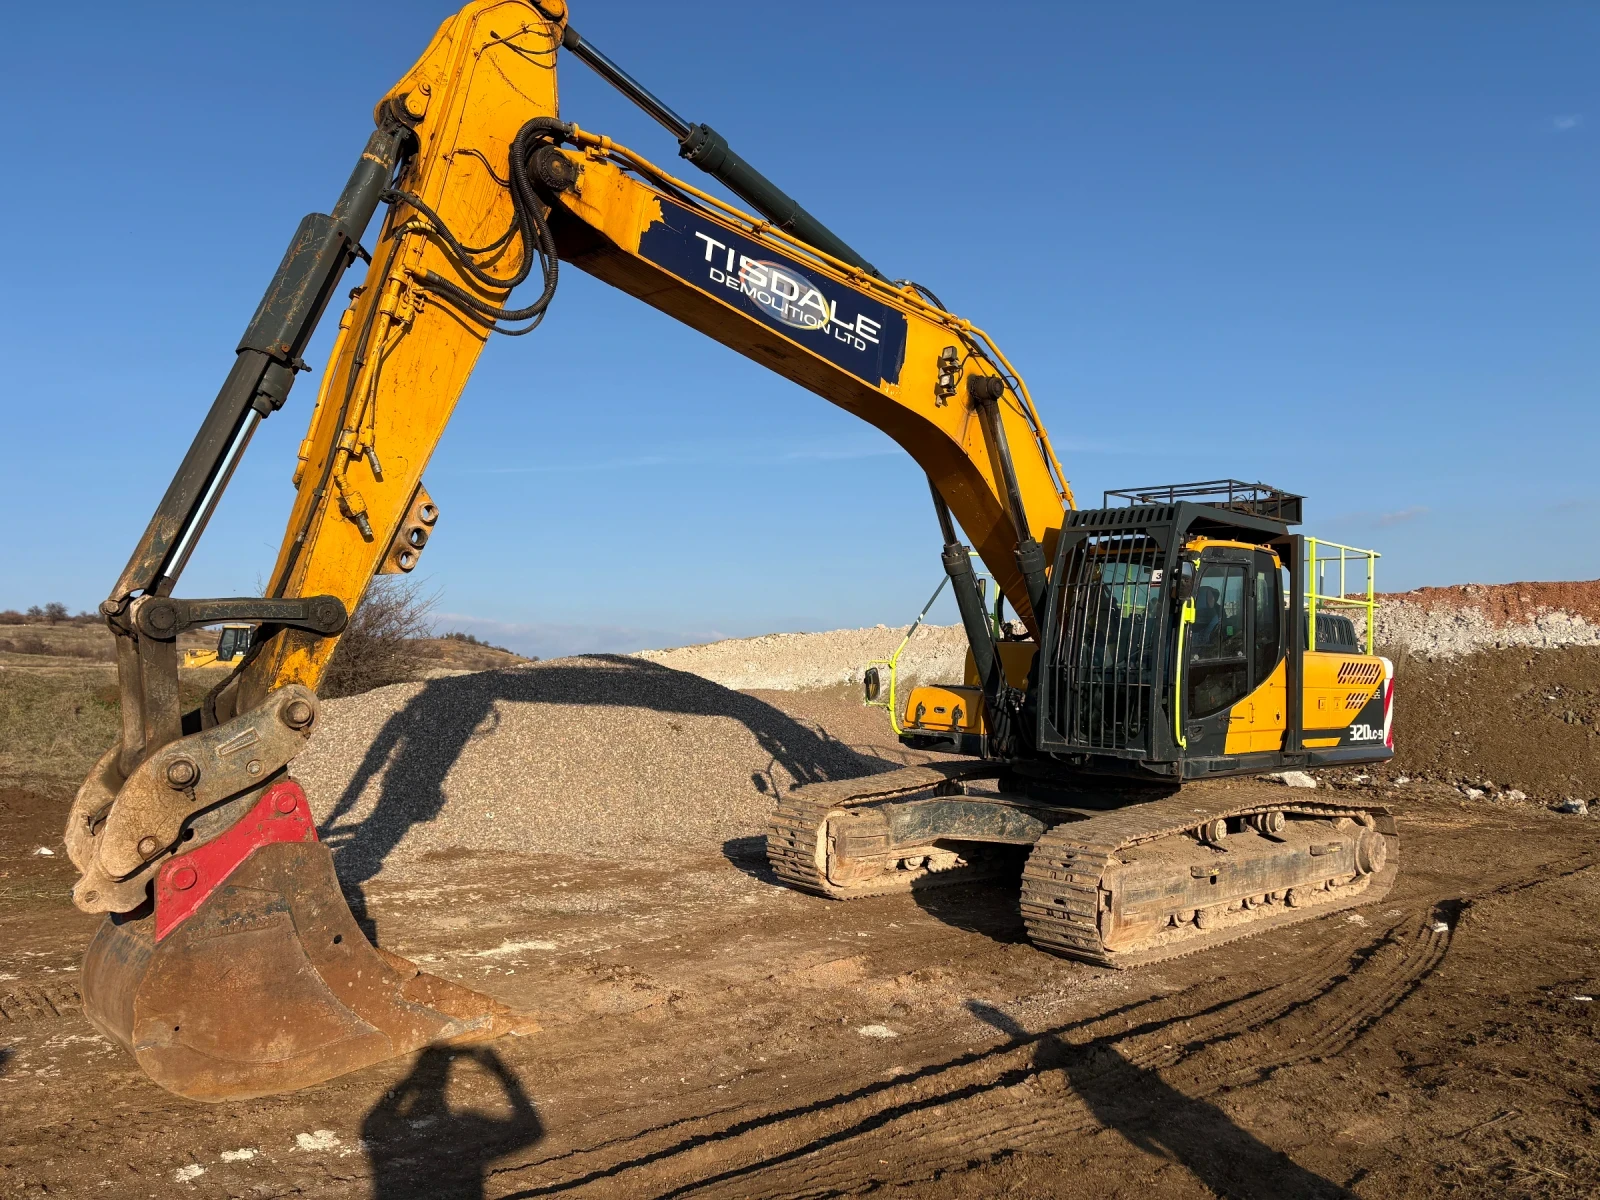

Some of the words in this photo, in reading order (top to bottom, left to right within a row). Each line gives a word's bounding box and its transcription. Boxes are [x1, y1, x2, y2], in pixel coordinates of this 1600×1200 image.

[695, 231, 881, 344] TISDALE
[709, 267, 831, 334] DEMOLITION
[835, 327, 867, 351] LTD
